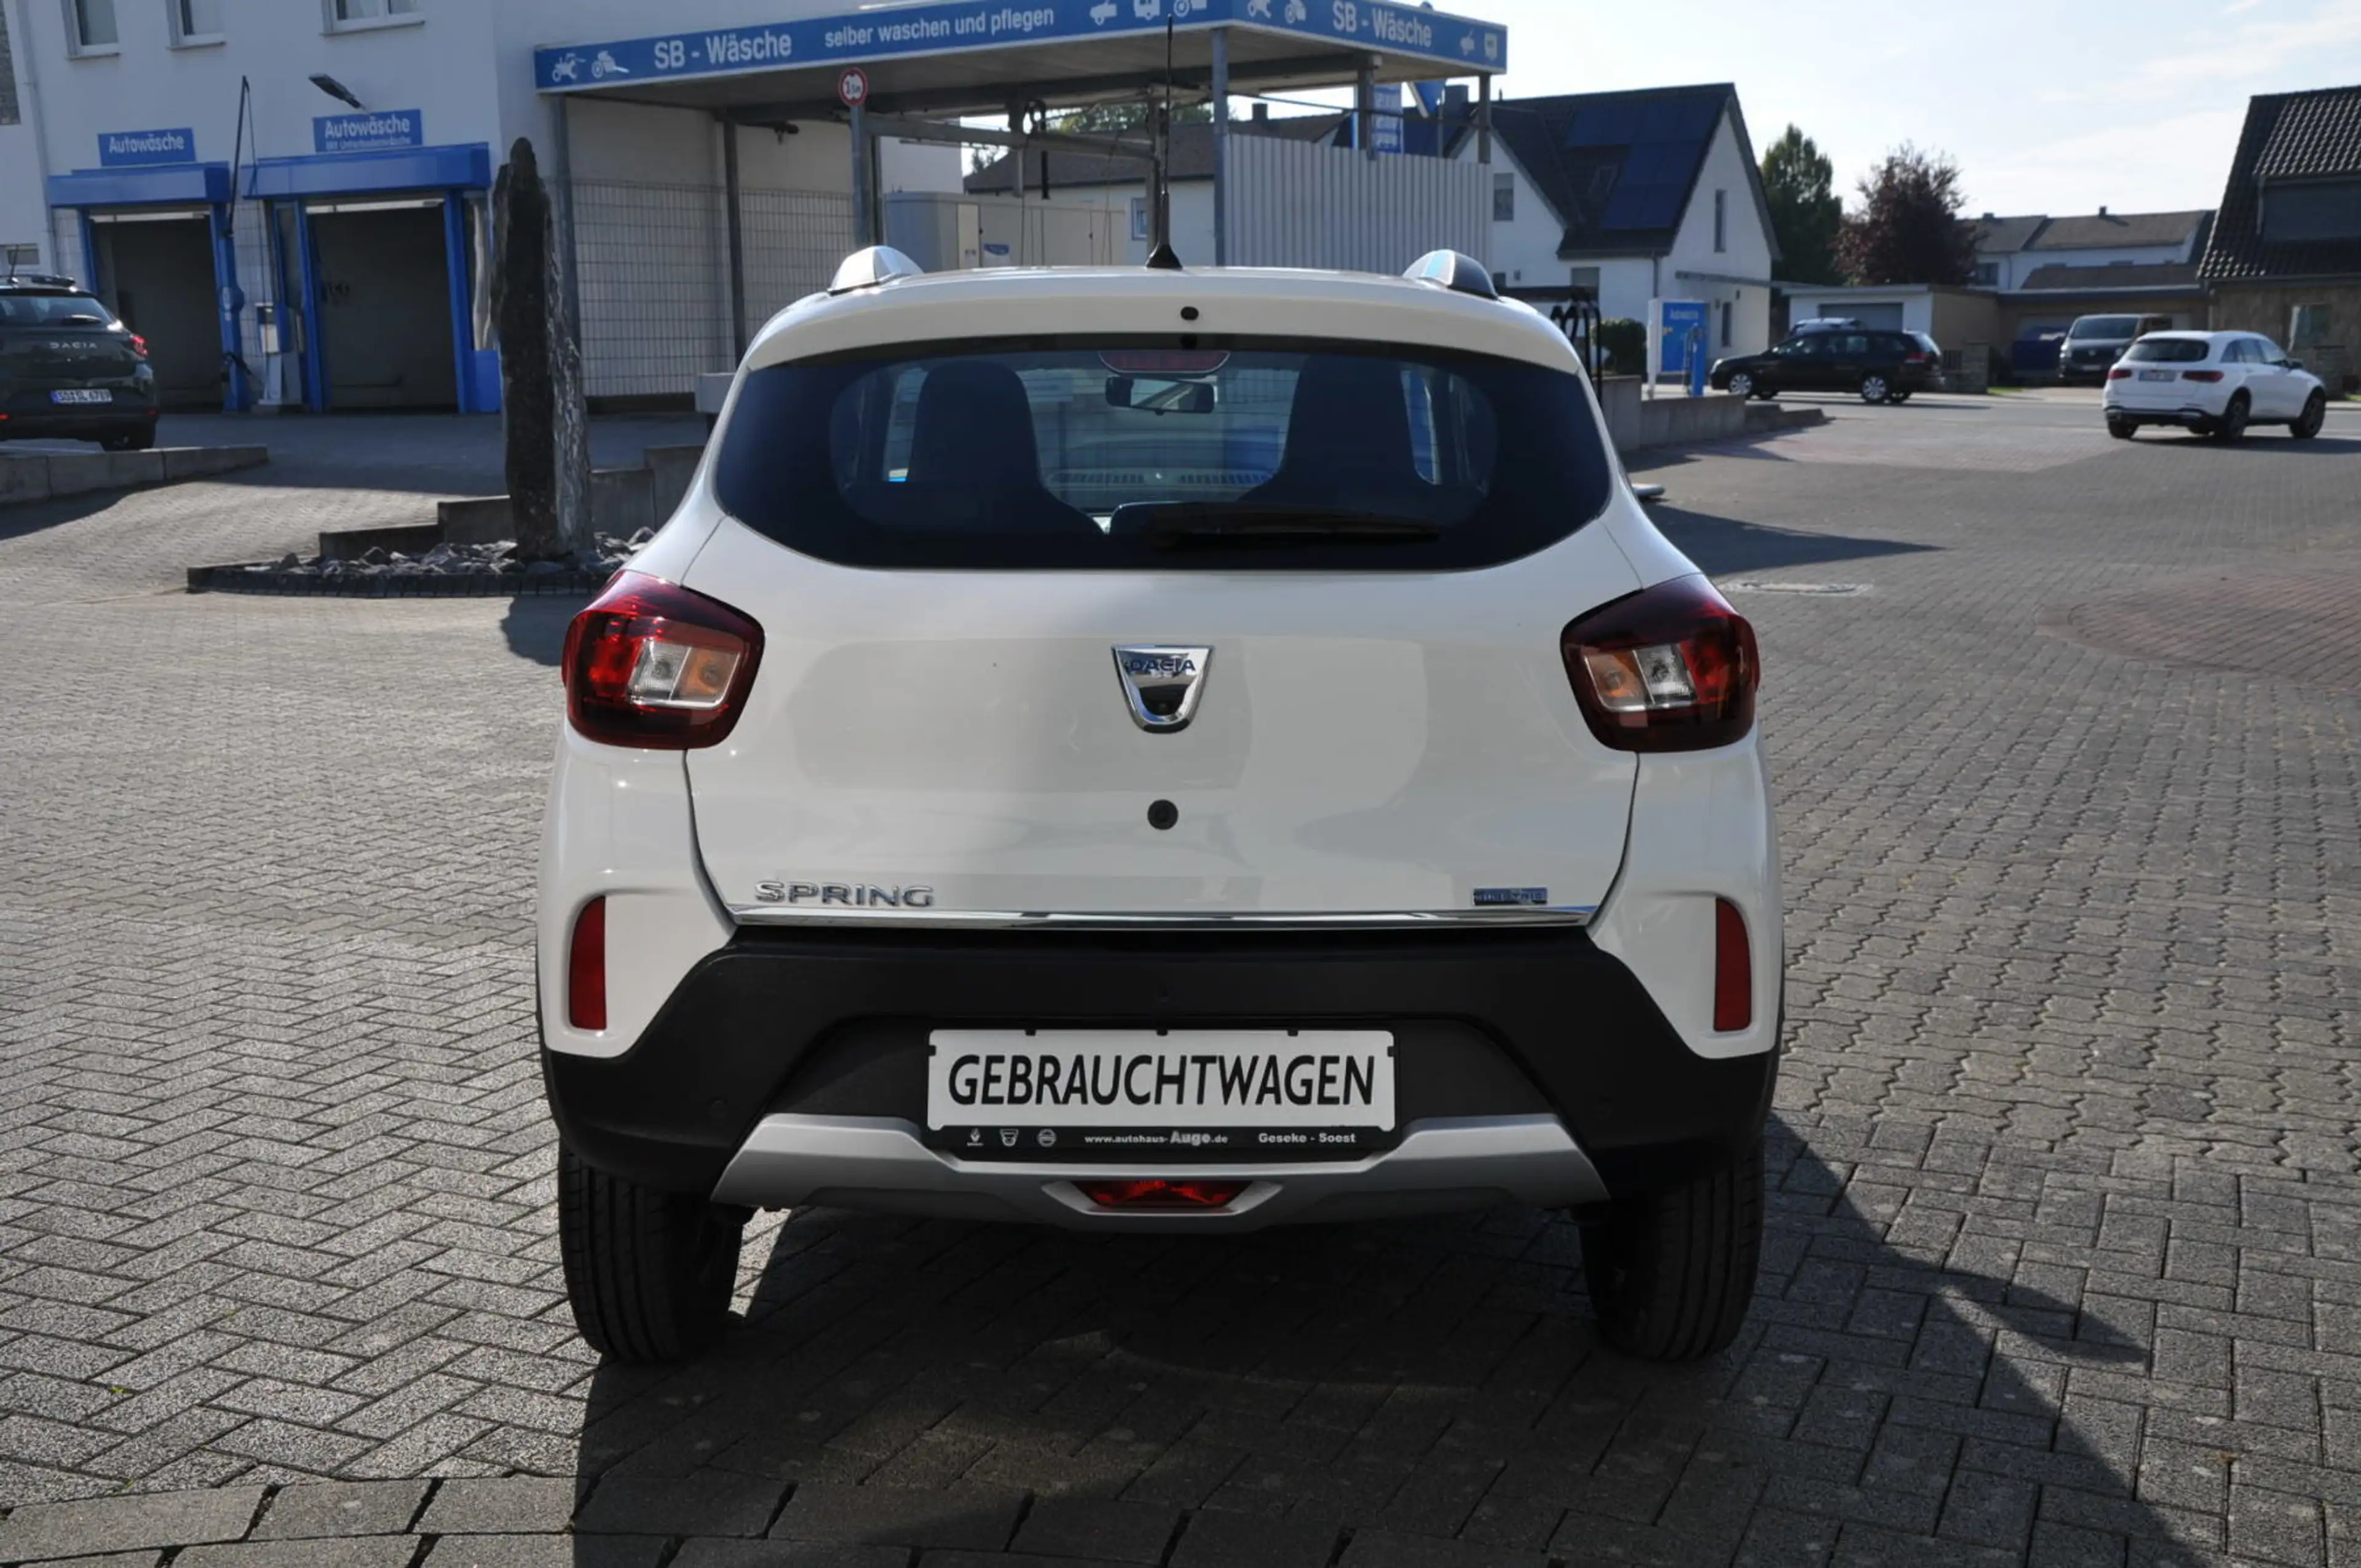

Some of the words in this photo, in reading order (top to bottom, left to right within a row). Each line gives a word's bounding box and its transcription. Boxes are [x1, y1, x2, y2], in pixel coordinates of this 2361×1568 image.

[825, 26, 873, 48] selber
[878, 18, 951, 42] waschen
[955, 12, 986, 34] und
[991, 7, 1054, 36] pflegen
[1332, 1, 1357, 33] SB
[1372, 7, 1432, 48] Wäsche
[654, 40, 685, 69] SB
[705, 30, 792, 65] Wäsche
[325, 112, 411, 140] Autowäsche
[108, 133, 185, 154] Autowäsche
[1129, 658, 1196, 672] DACIA
[754, 880, 935, 908] SPRING
[948, 1054, 1375, 1106] GEBRAUCHTWAGEN
[1084, 1130, 1229, 1146] www.autohaus-Auge.de
[1258, 1132, 1307, 1144] Geseke
[1318, 1132, 1356, 1144] Soest
